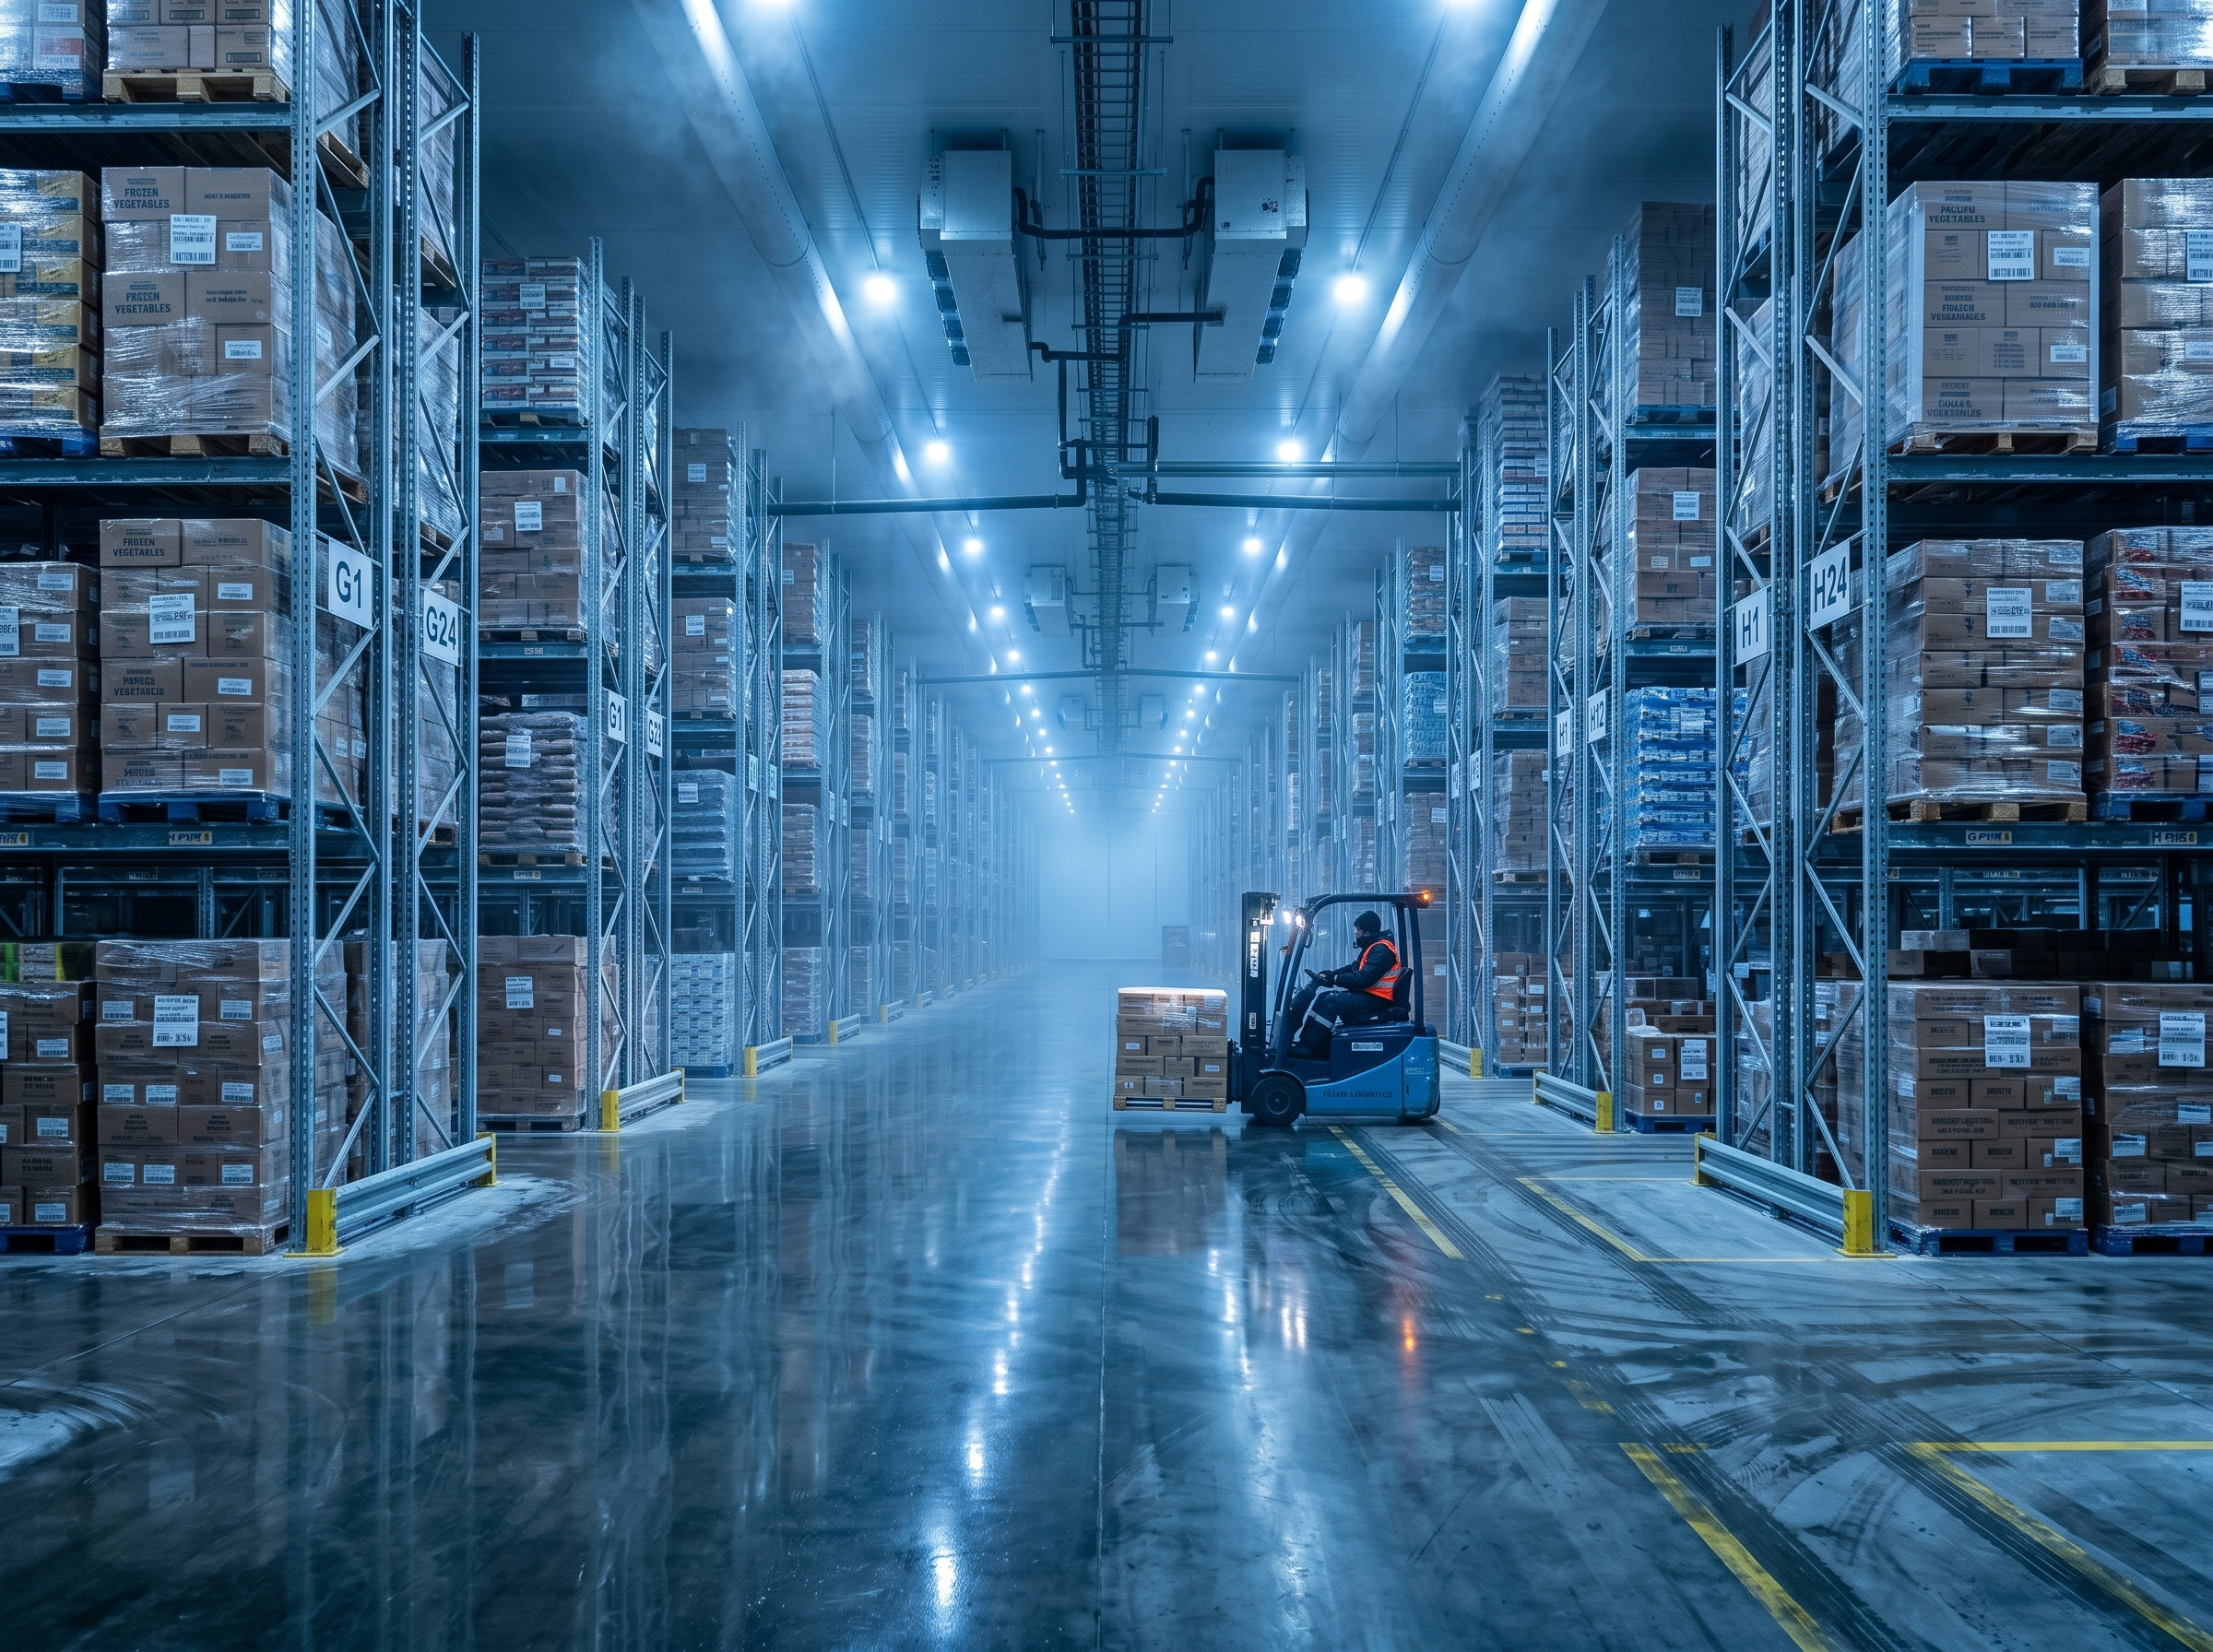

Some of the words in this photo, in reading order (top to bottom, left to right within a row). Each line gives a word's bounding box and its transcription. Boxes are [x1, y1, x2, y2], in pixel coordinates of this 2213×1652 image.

[336, 560, 361, 609] G1
[1814, 556, 1847, 613] H24
[426, 606, 456, 651] G24
[1742, 606, 1758, 649] H1
[609, 701, 621, 731] G1
